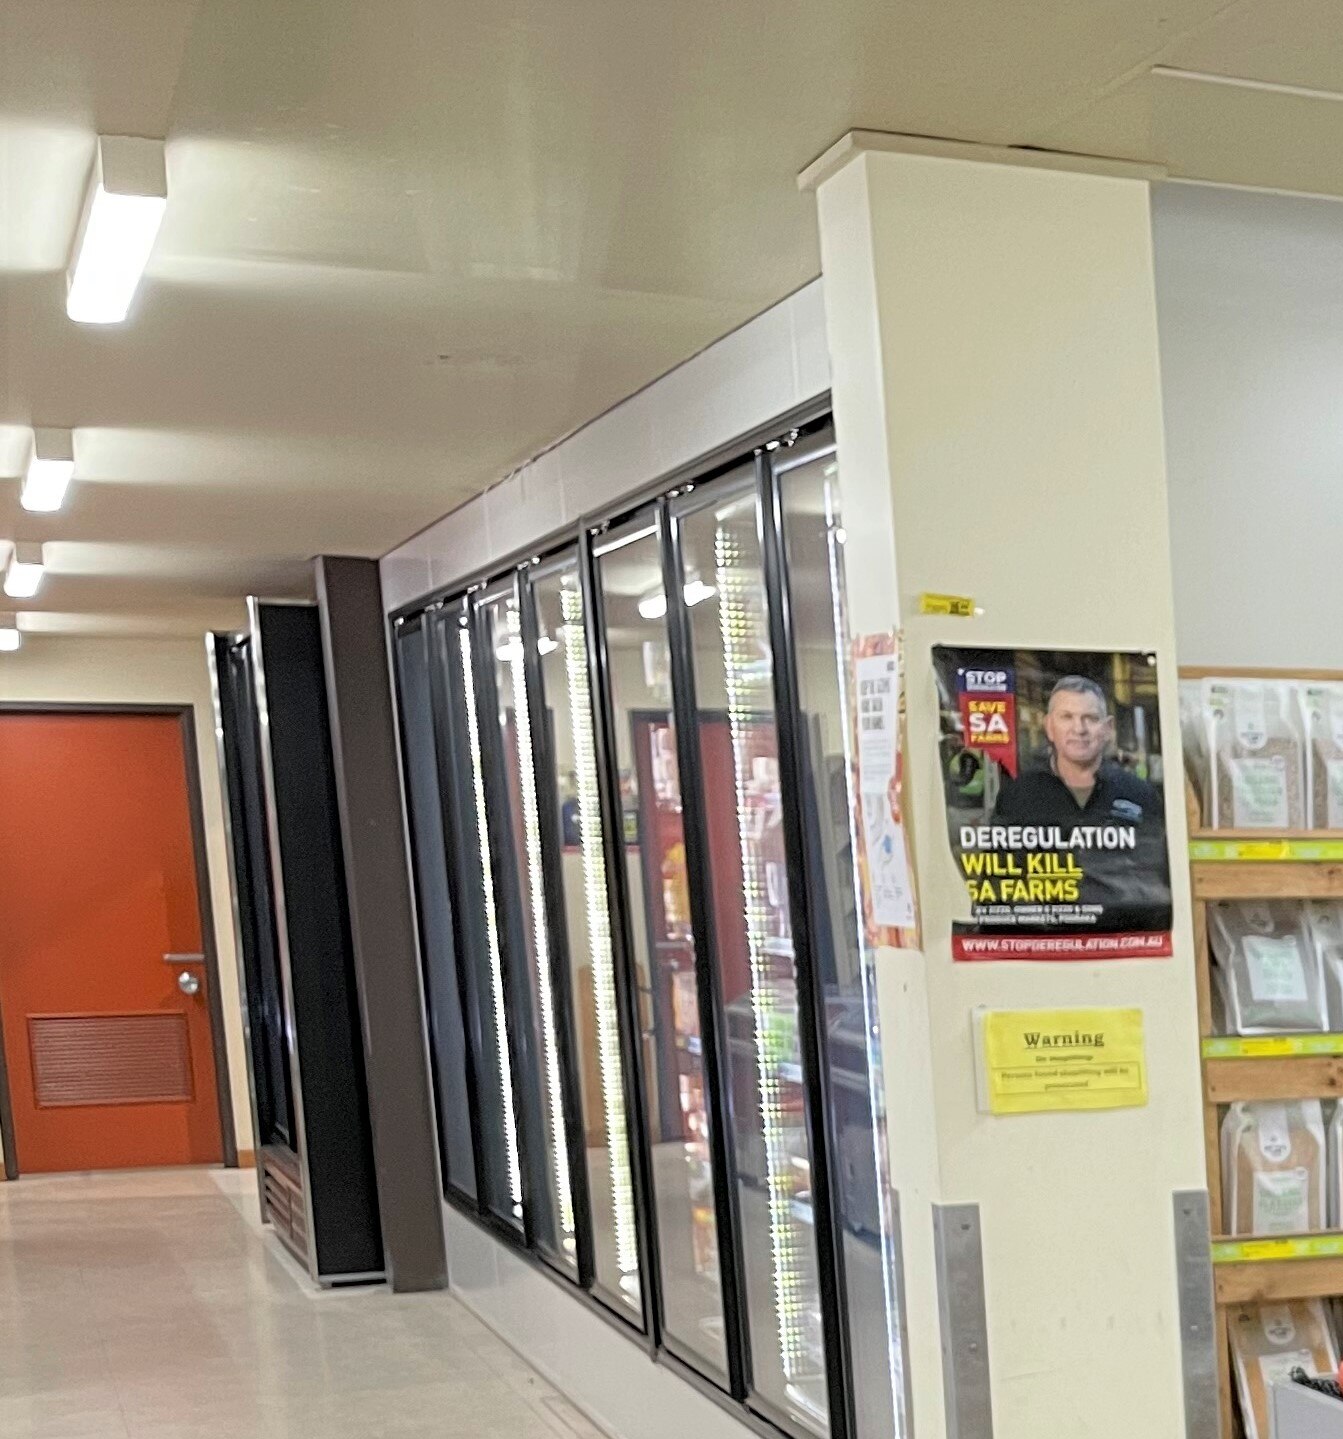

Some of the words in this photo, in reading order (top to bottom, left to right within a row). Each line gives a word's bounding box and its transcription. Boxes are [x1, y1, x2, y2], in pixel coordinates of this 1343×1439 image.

[966, 671, 1007, 684] STOP
[968, 701, 1006, 713] SAVE
[969, 713, 1009, 733] SA
[960, 826, 1136, 849] DEREGULATION
[961, 853, 1022, 876] WILL
[1026, 853, 1083, 877] KILL
[1001, 879, 1080, 902] FARMS
[1023, 1031, 1105, 1049] Warning
